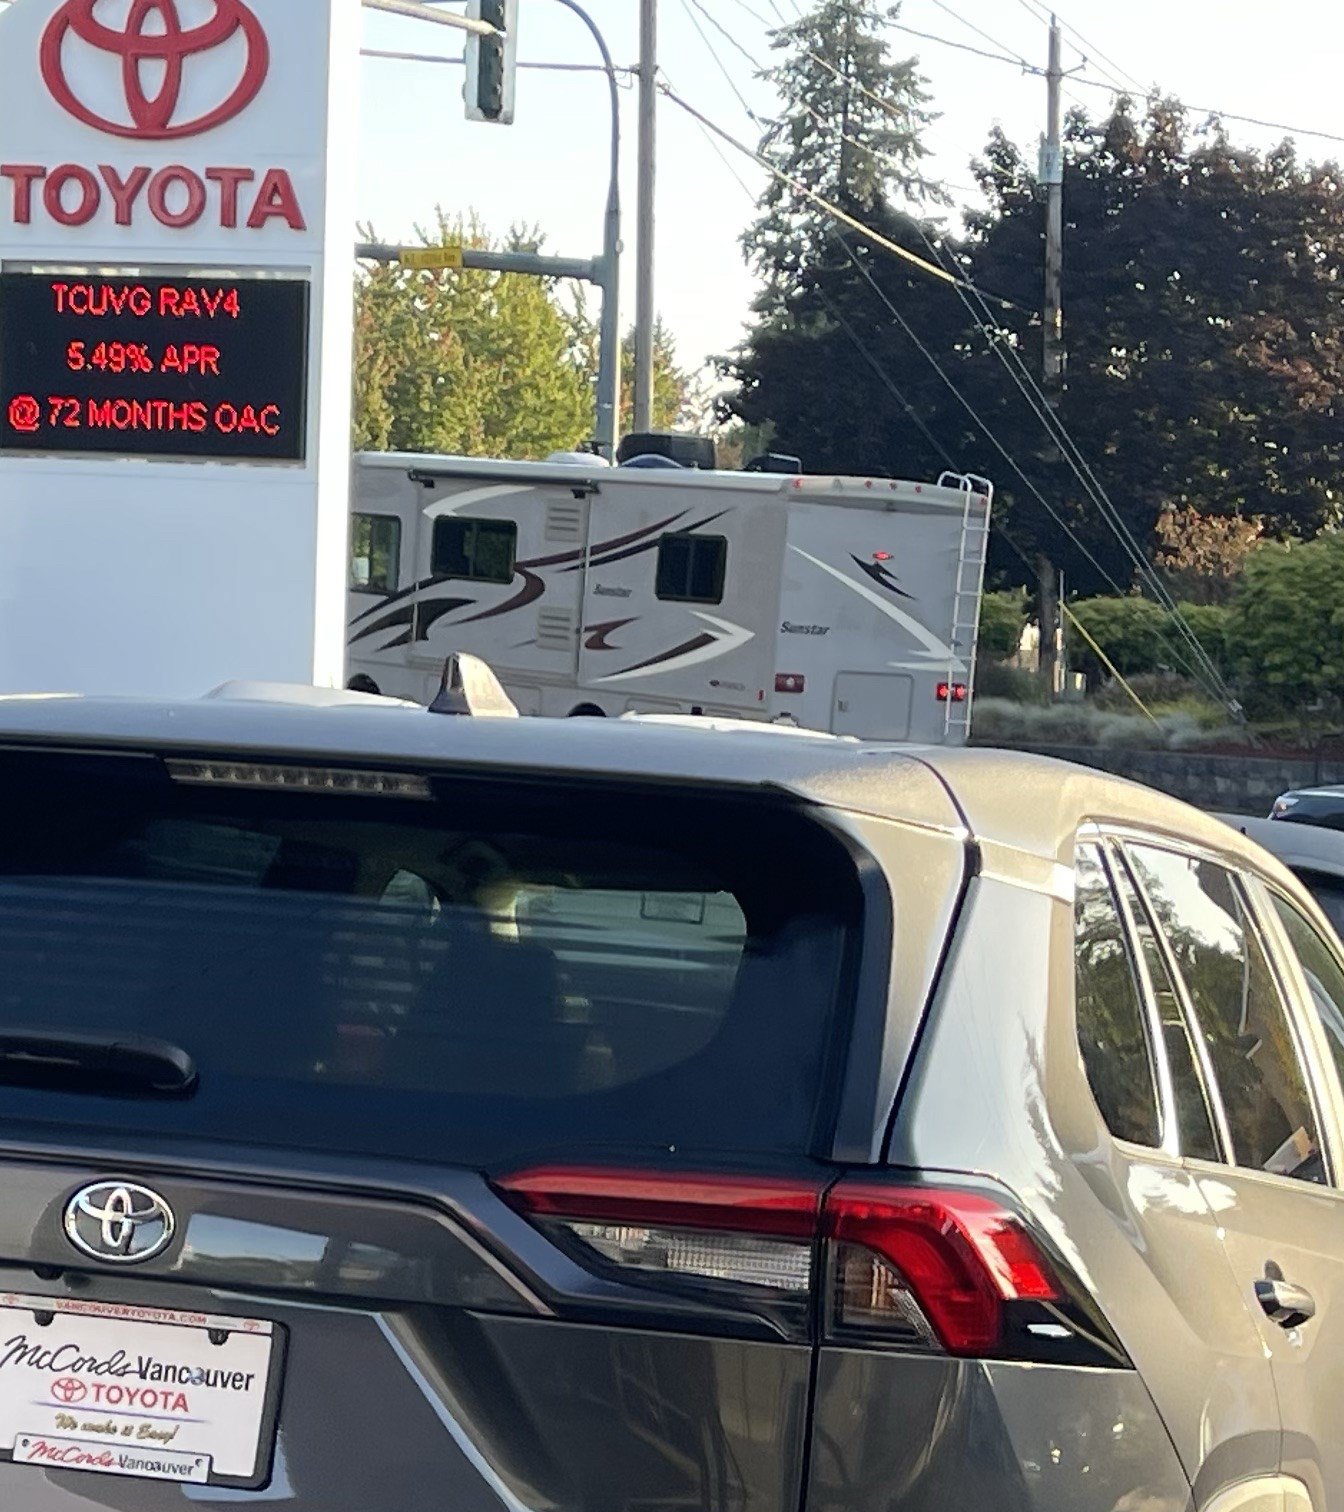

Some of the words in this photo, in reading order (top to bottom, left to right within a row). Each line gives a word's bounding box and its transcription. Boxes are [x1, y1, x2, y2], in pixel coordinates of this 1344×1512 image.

[0, 163, 307, 231] TOYOTA
[158, 286, 240, 319] RAV4
[67, 341, 154, 374] 5.49%
[160, 344, 221, 375] APR
[8, 395, 40, 431] @
[48, 396, 81, 428] 72
[88, 399, 208, 433] MONTHS
[214, 403, 280, 436] OAC
[780, 621, 830, 635] Sunstar
[92, 1383, 189, 1413] TOYOTA
